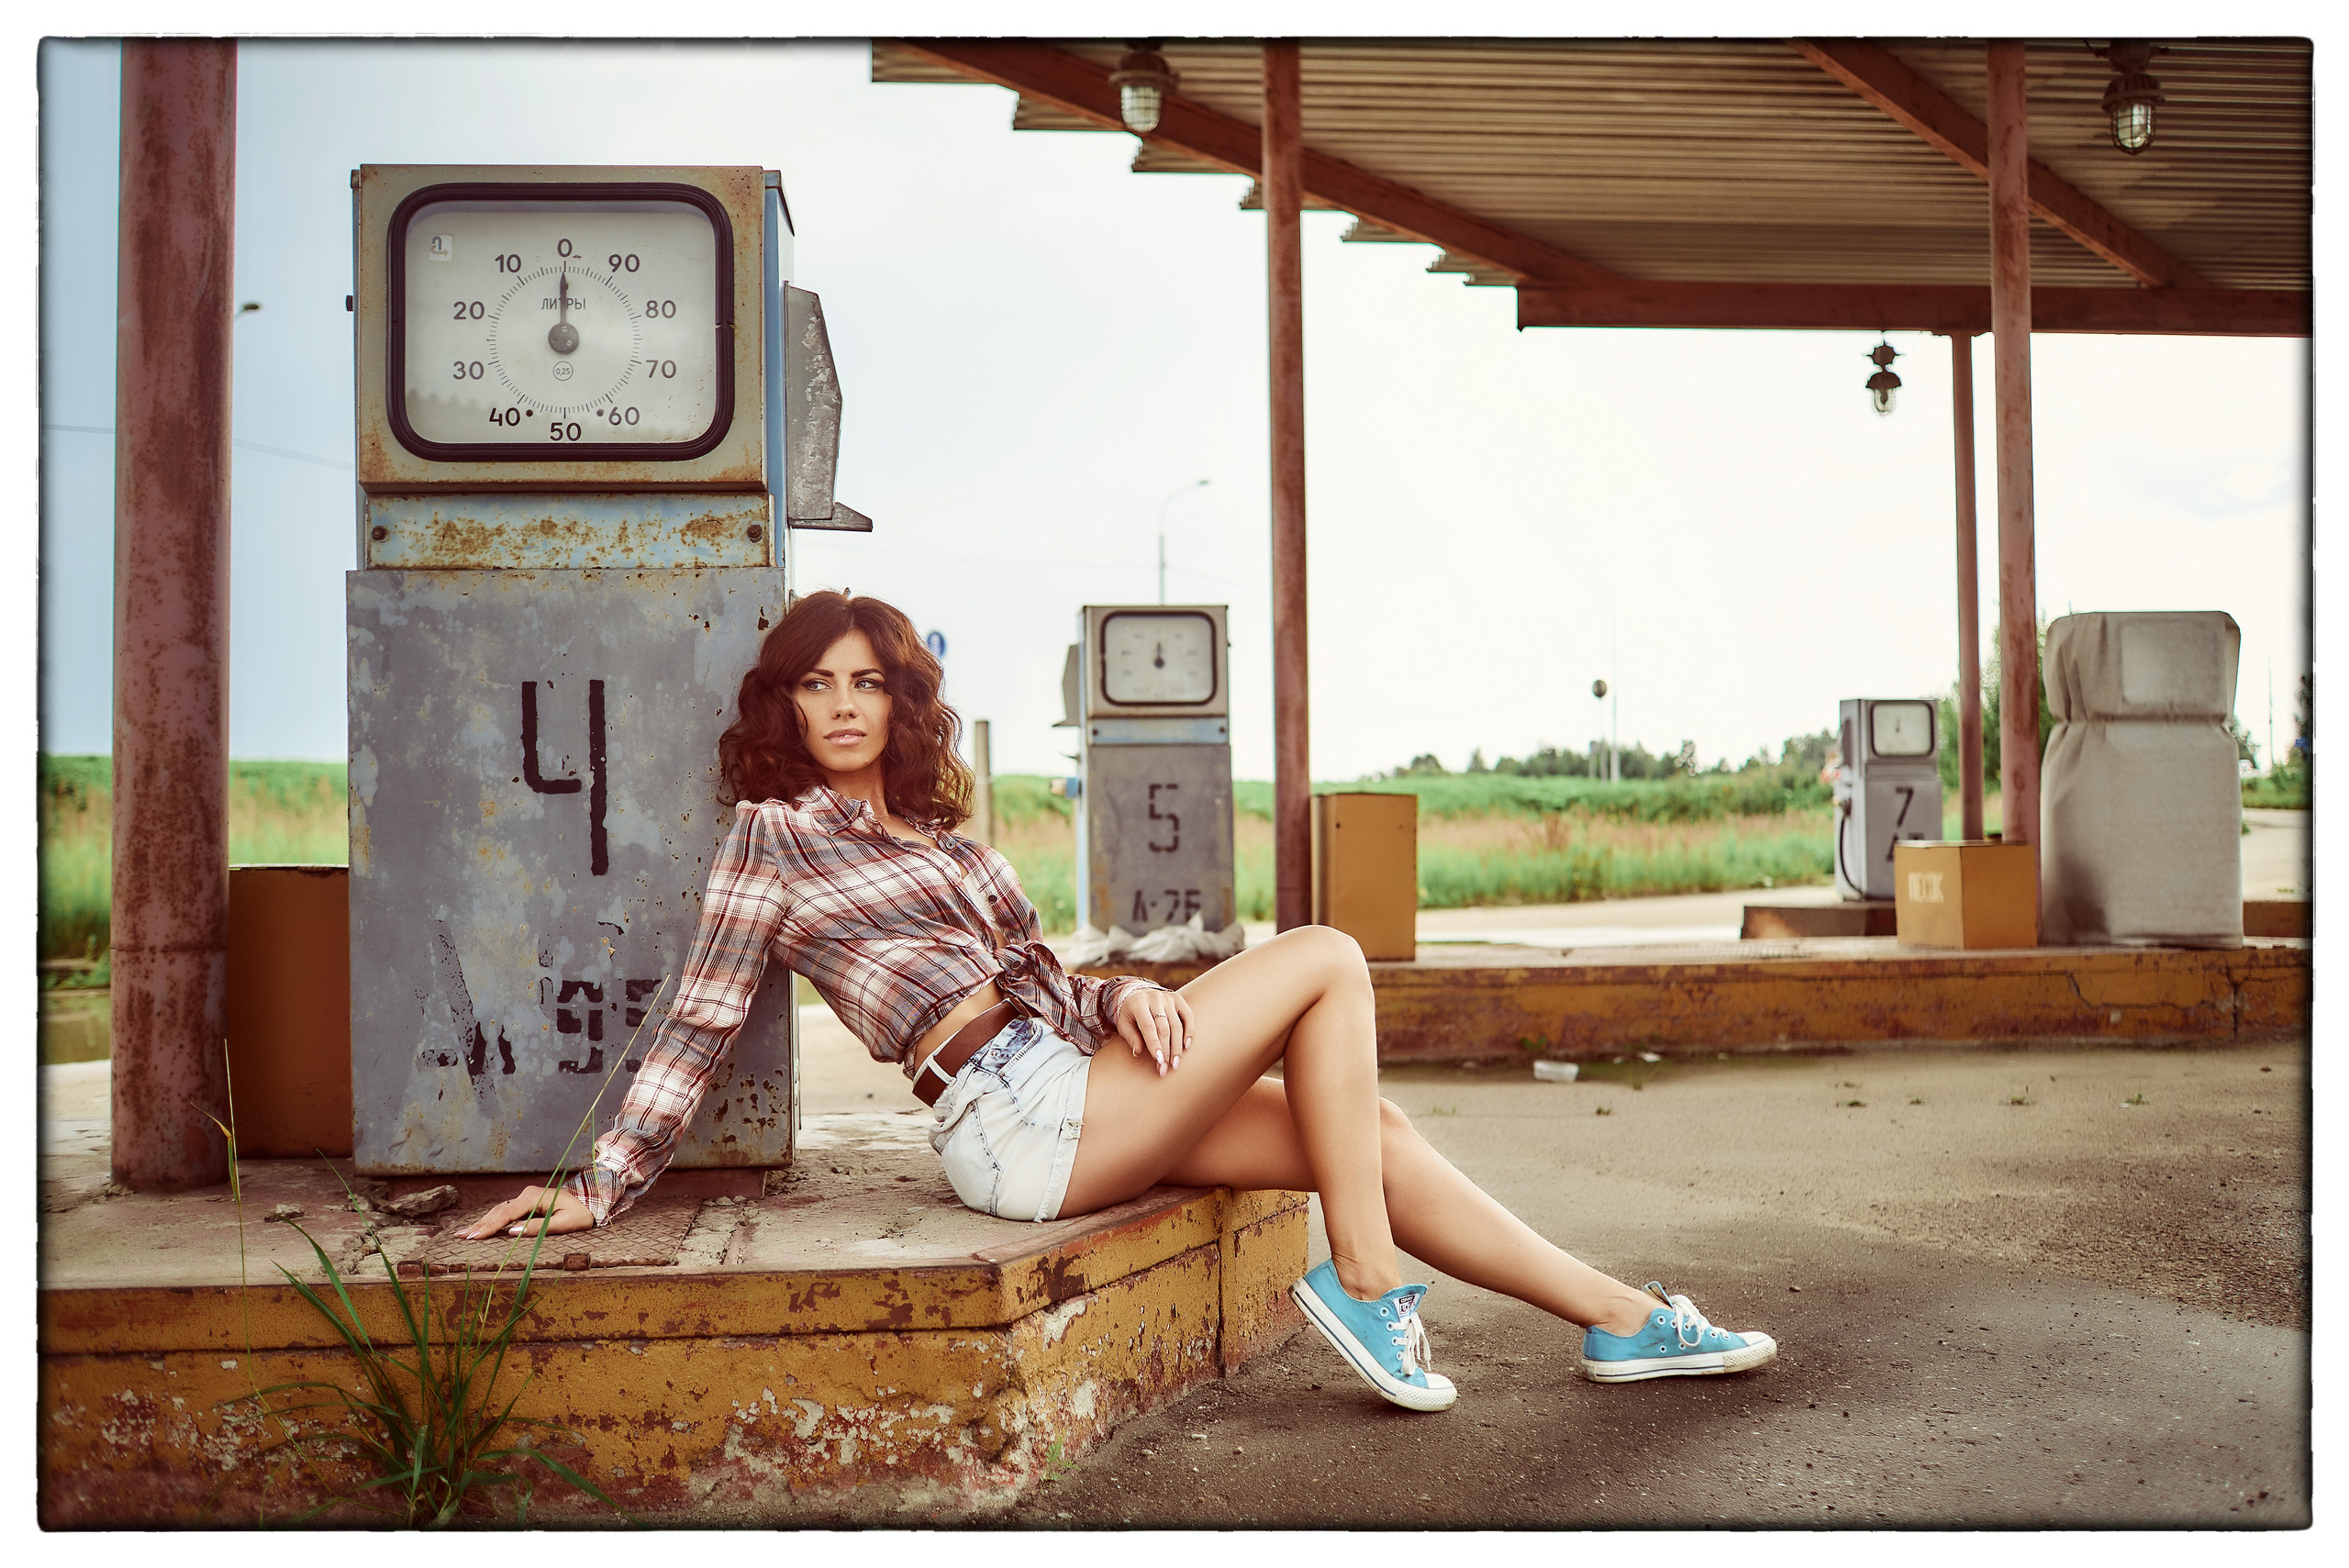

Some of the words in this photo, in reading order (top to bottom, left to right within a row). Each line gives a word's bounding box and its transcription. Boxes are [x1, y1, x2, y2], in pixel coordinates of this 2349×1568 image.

[557, 239, 573, 258] 0
[495, 254, 521, 272] 10
[608, 254, 640, 272] 90
[453, 301, 484, 319] 20
[646, 300, 676, 318] 80
[453, 361, 484, 380] 30
[555, 367, 571, 377] 0,25
[646, 361, 676, 378] 70
[489, 407, 521, 427] 40
[608, 407, 640, 426] 60
[550, 423, 582, 441] 50
[521, 679, 608, 875] 4
[1896, 786, 1914, 828] 7
[1148, 783, 1180, 852] 5
